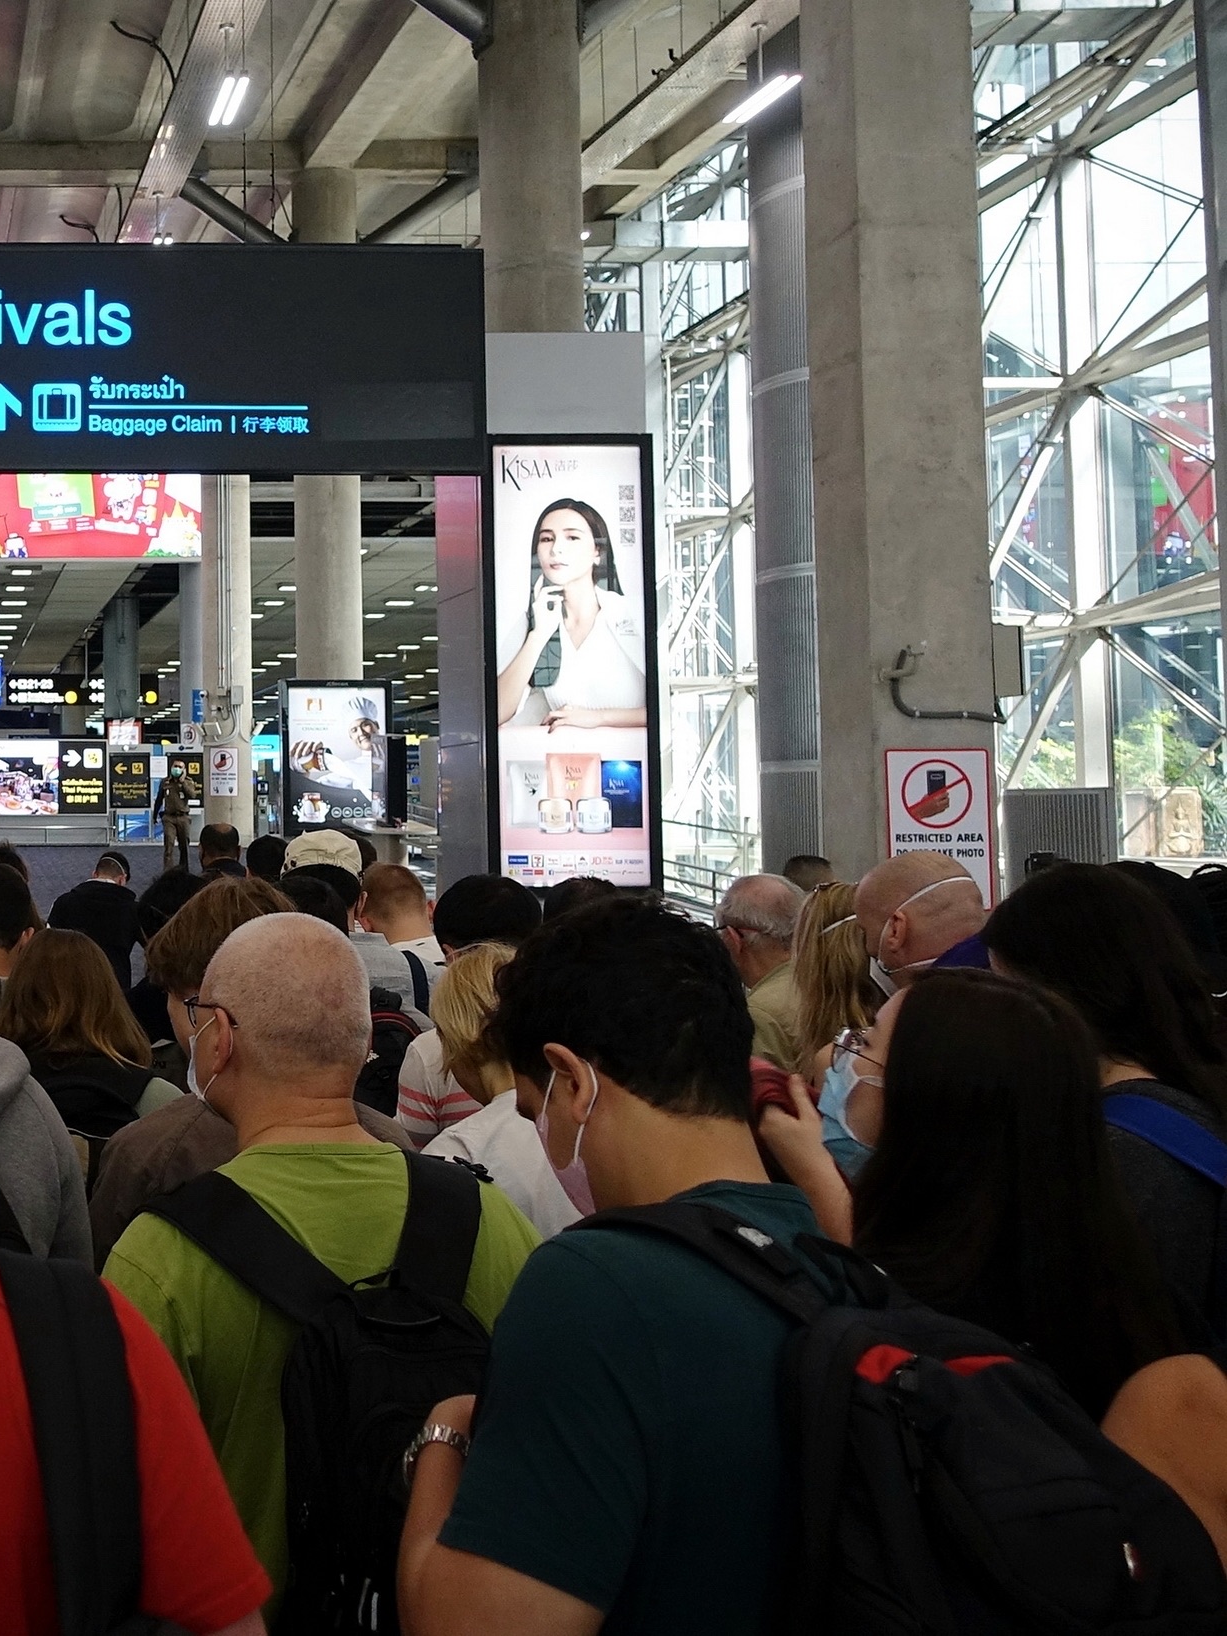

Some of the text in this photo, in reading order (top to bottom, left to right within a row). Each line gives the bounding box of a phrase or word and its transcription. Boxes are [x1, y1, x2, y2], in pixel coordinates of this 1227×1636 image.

[88, 374, 185, 400] รับกระเป๋า
[88, 415, 222, 436] Baggage Claim
[242, 416, 310, 434] 行李领取
[895, 833, 984, 843] RESTRICTED AREA
[956, 848, 985, 858] PHOTO
